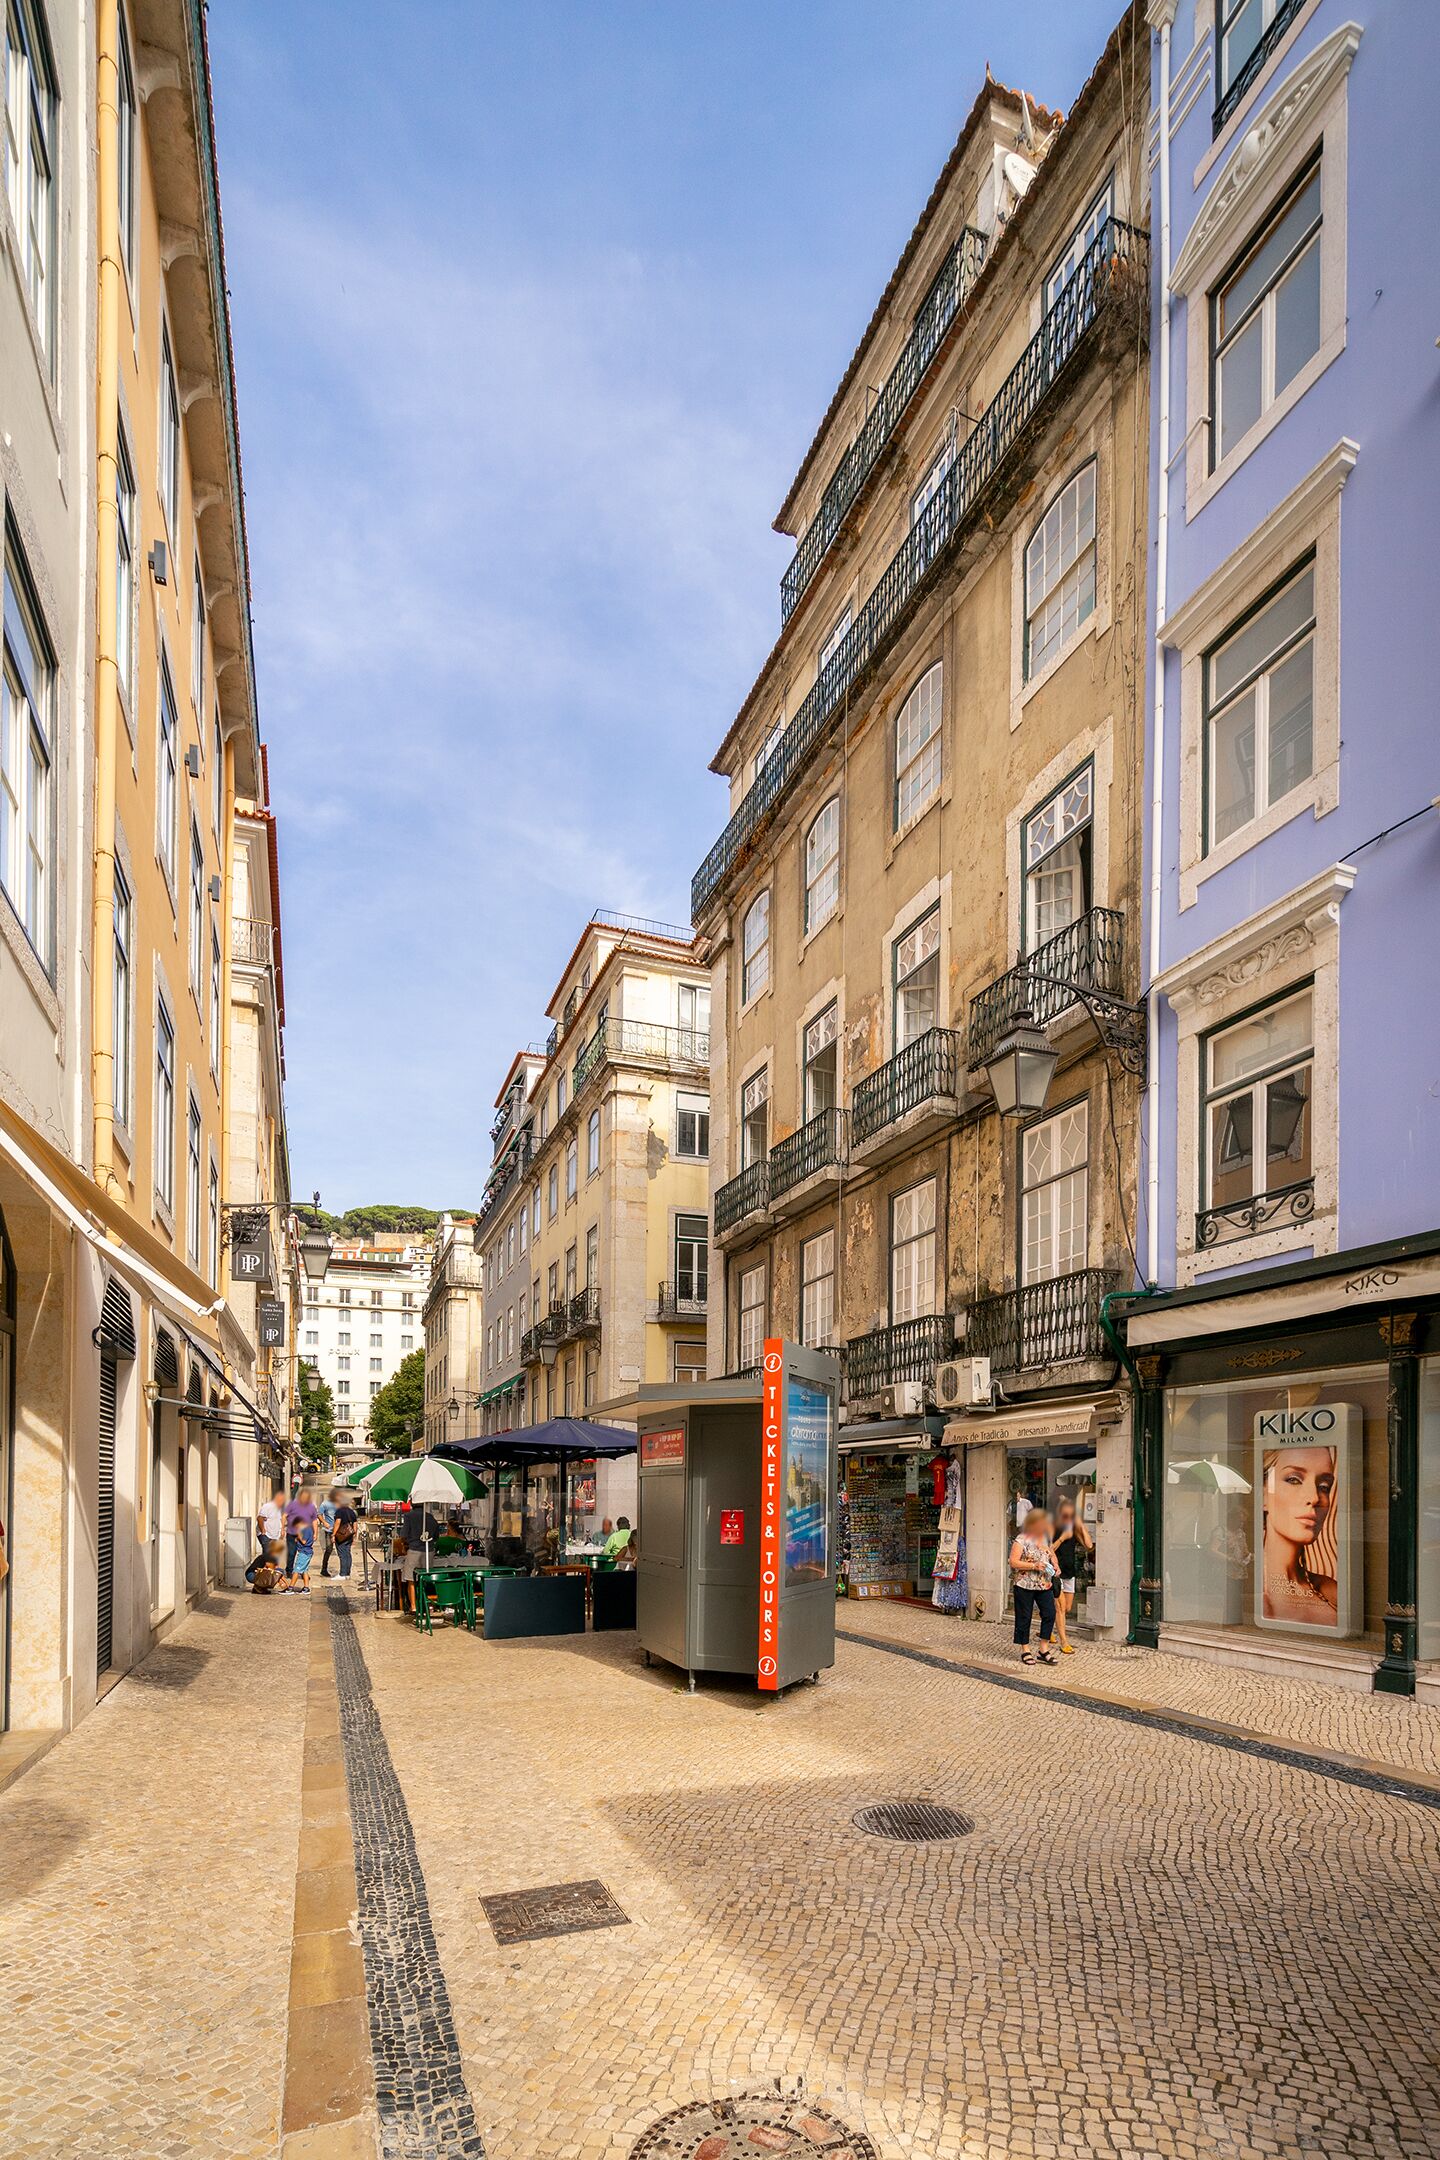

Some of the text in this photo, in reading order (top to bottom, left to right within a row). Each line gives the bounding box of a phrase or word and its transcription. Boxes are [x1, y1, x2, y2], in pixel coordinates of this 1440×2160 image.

[1345, 1271, 1399, 1294] KIKO
[1358, 1288, 1384, 1296] MILANO
[1260, 1409, 1336, 1435] KIKO
[970, 1431, 979, 1441] de
[980, 1429, 1010, 1441] Tradição
[1017, 1426, 1051, 1437] artesanato
[1055, 1420, 1089, 1433] handicraft
[1280, 1435, 1315, 1443] MILANO
[1109, 1495, 1119, 1505] AL
[763, 1386, 778, 1642] TICKETS & TOURS
[1271, 1586, 1314, 1598] KONSCIOUS
